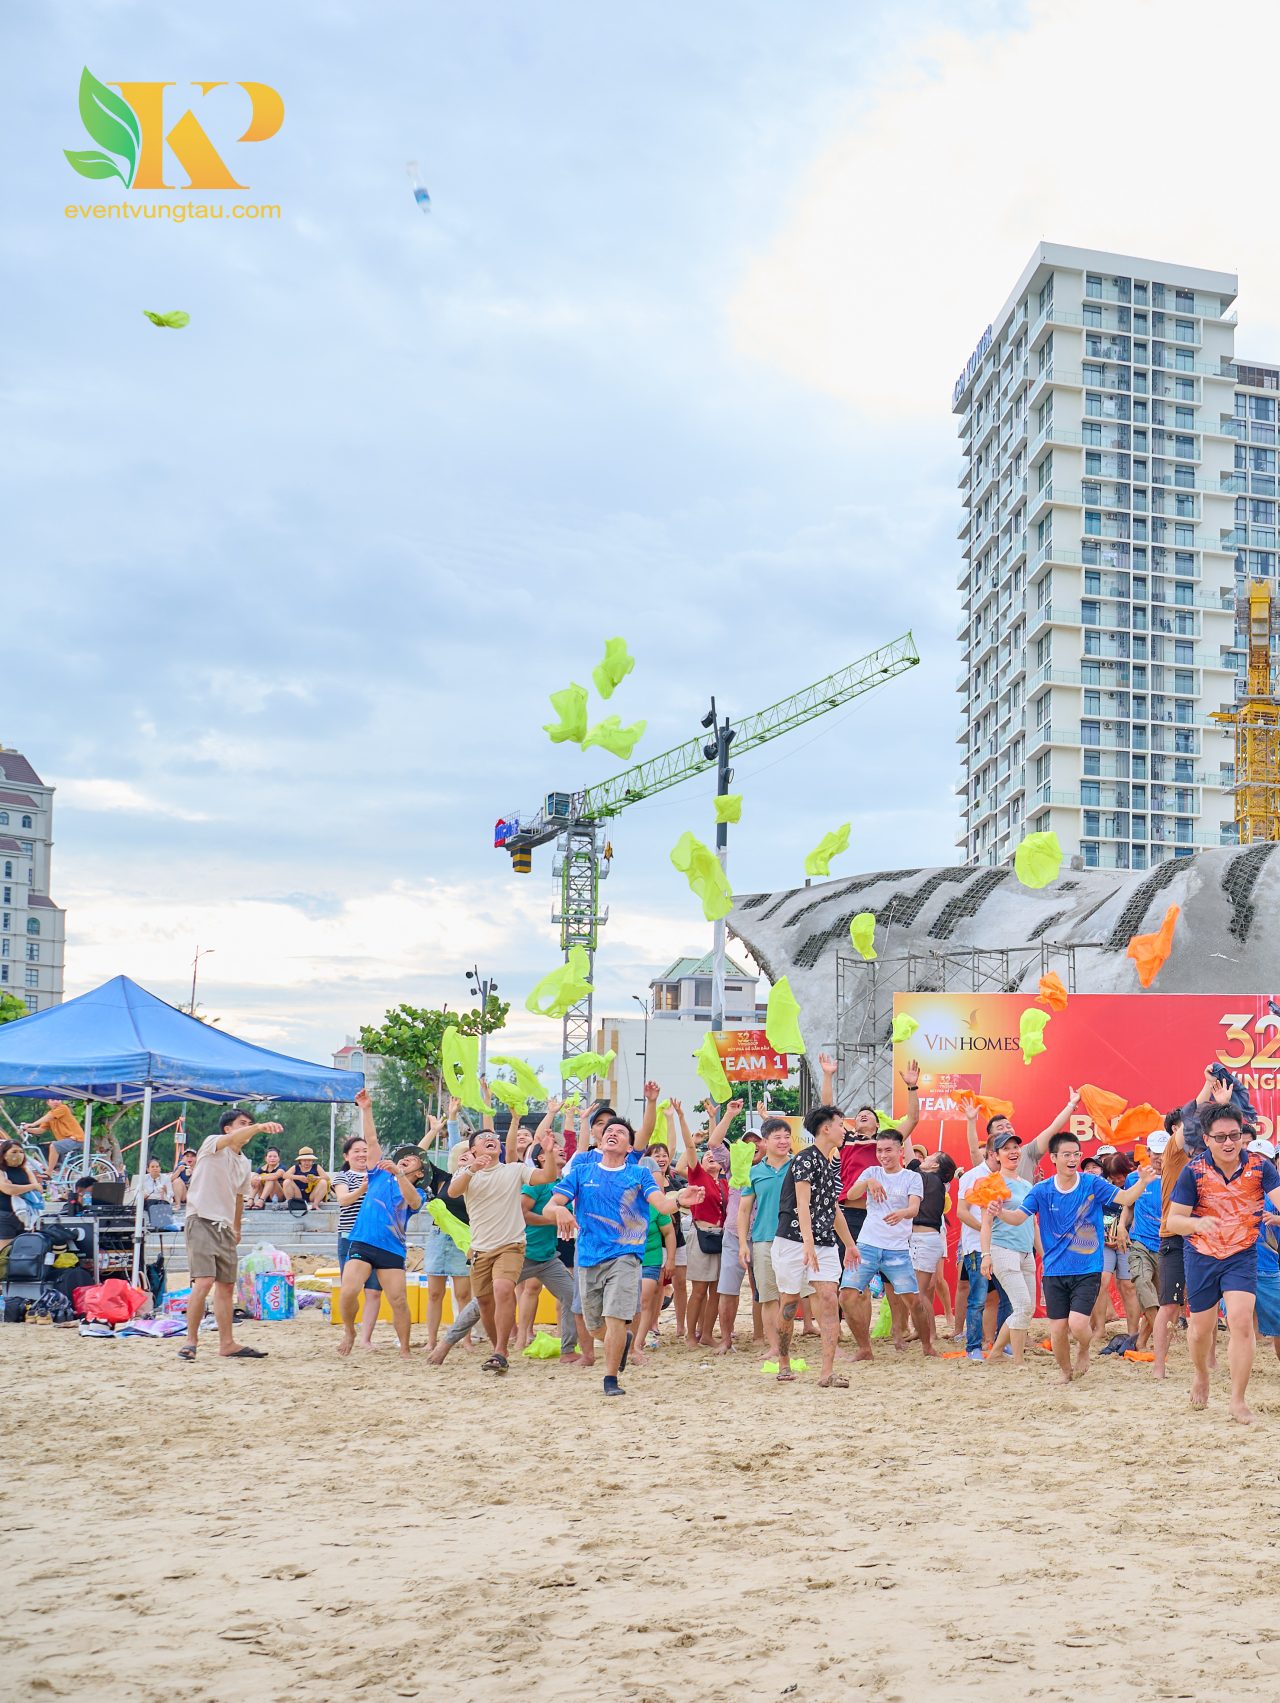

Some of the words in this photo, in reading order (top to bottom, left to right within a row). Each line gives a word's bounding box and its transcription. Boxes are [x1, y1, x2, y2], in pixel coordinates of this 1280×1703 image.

[925, 1034, 1021, 1051] VINHOMES
[773, 1055, 784, 1069] 1
[918, 1097, 959, 1111] TEAM
